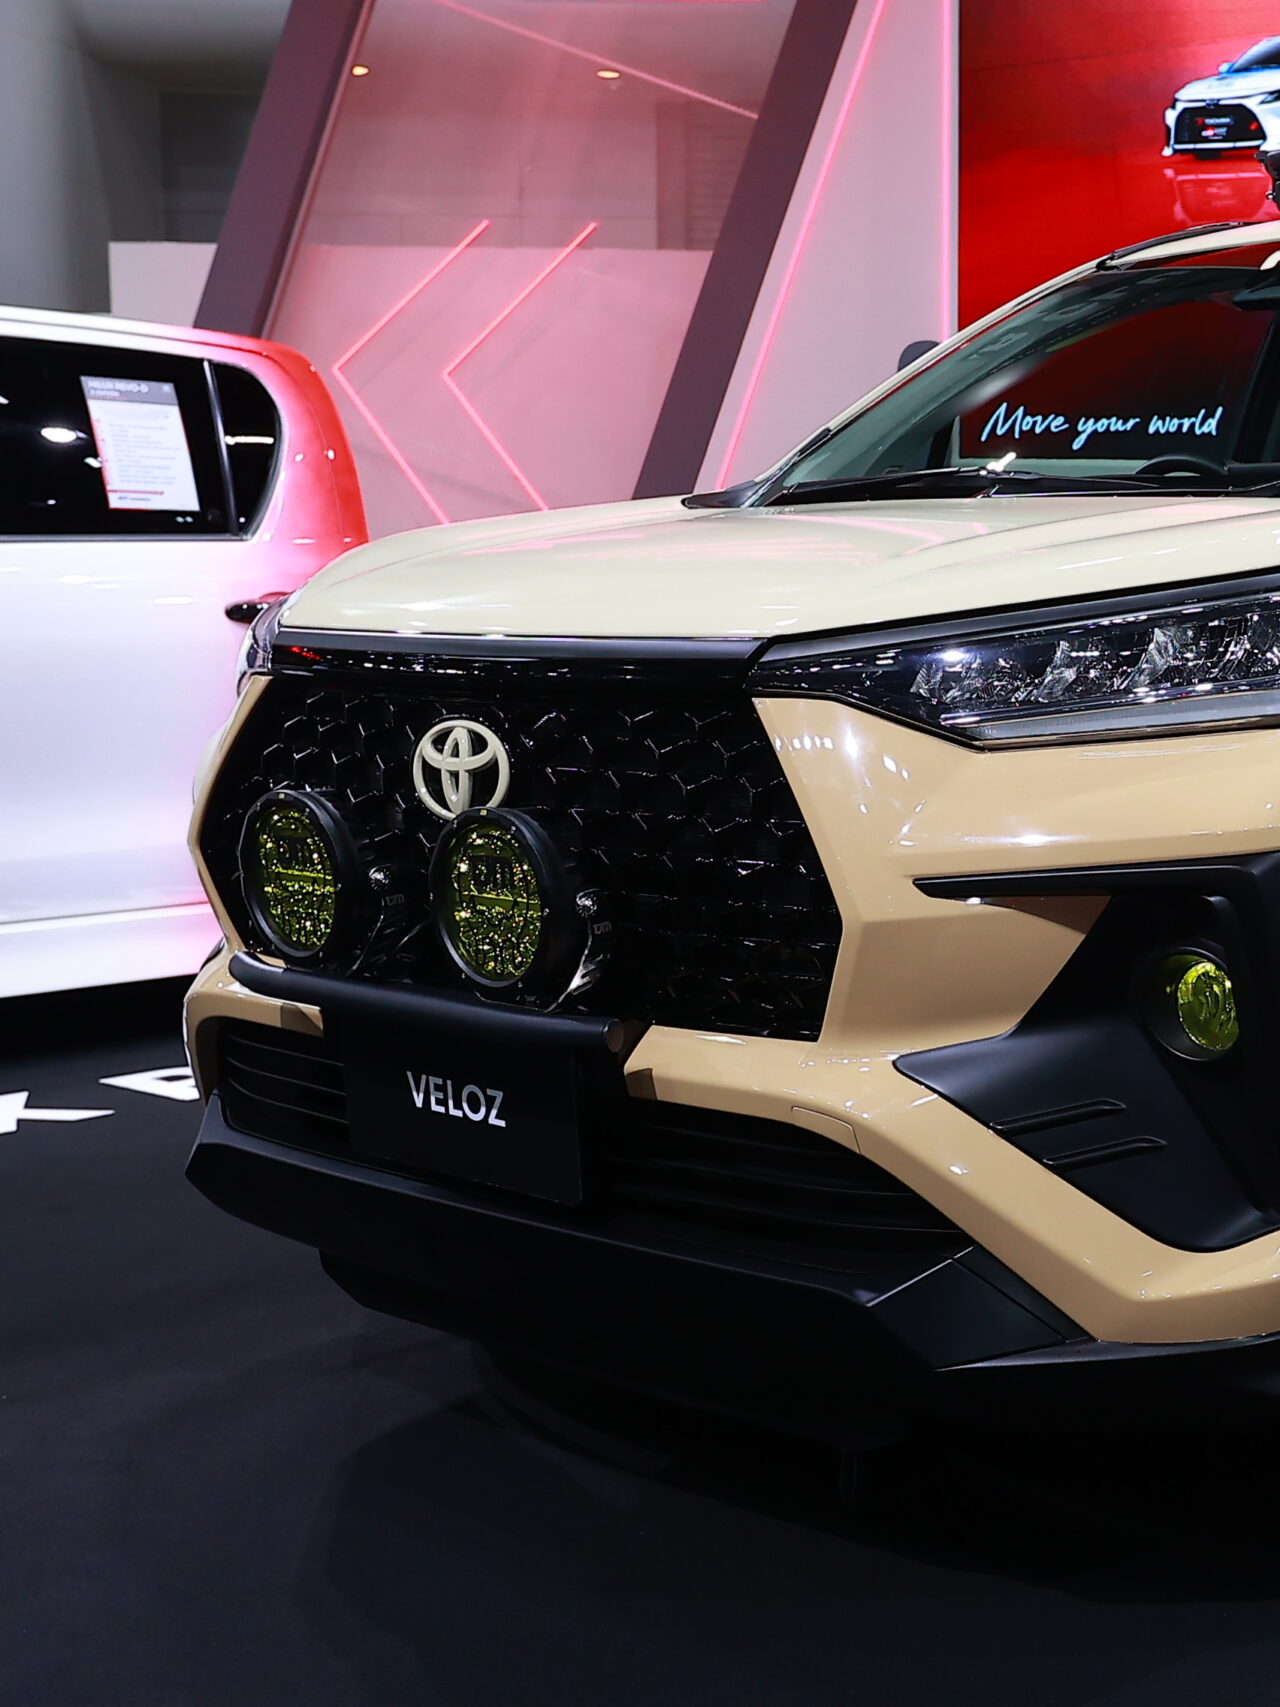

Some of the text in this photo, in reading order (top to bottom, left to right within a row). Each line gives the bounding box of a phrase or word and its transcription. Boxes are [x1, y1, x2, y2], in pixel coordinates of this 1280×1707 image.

[981, 402, 1223, 450] Move your world
[406, 1070, 507, 1128] VELOZ
